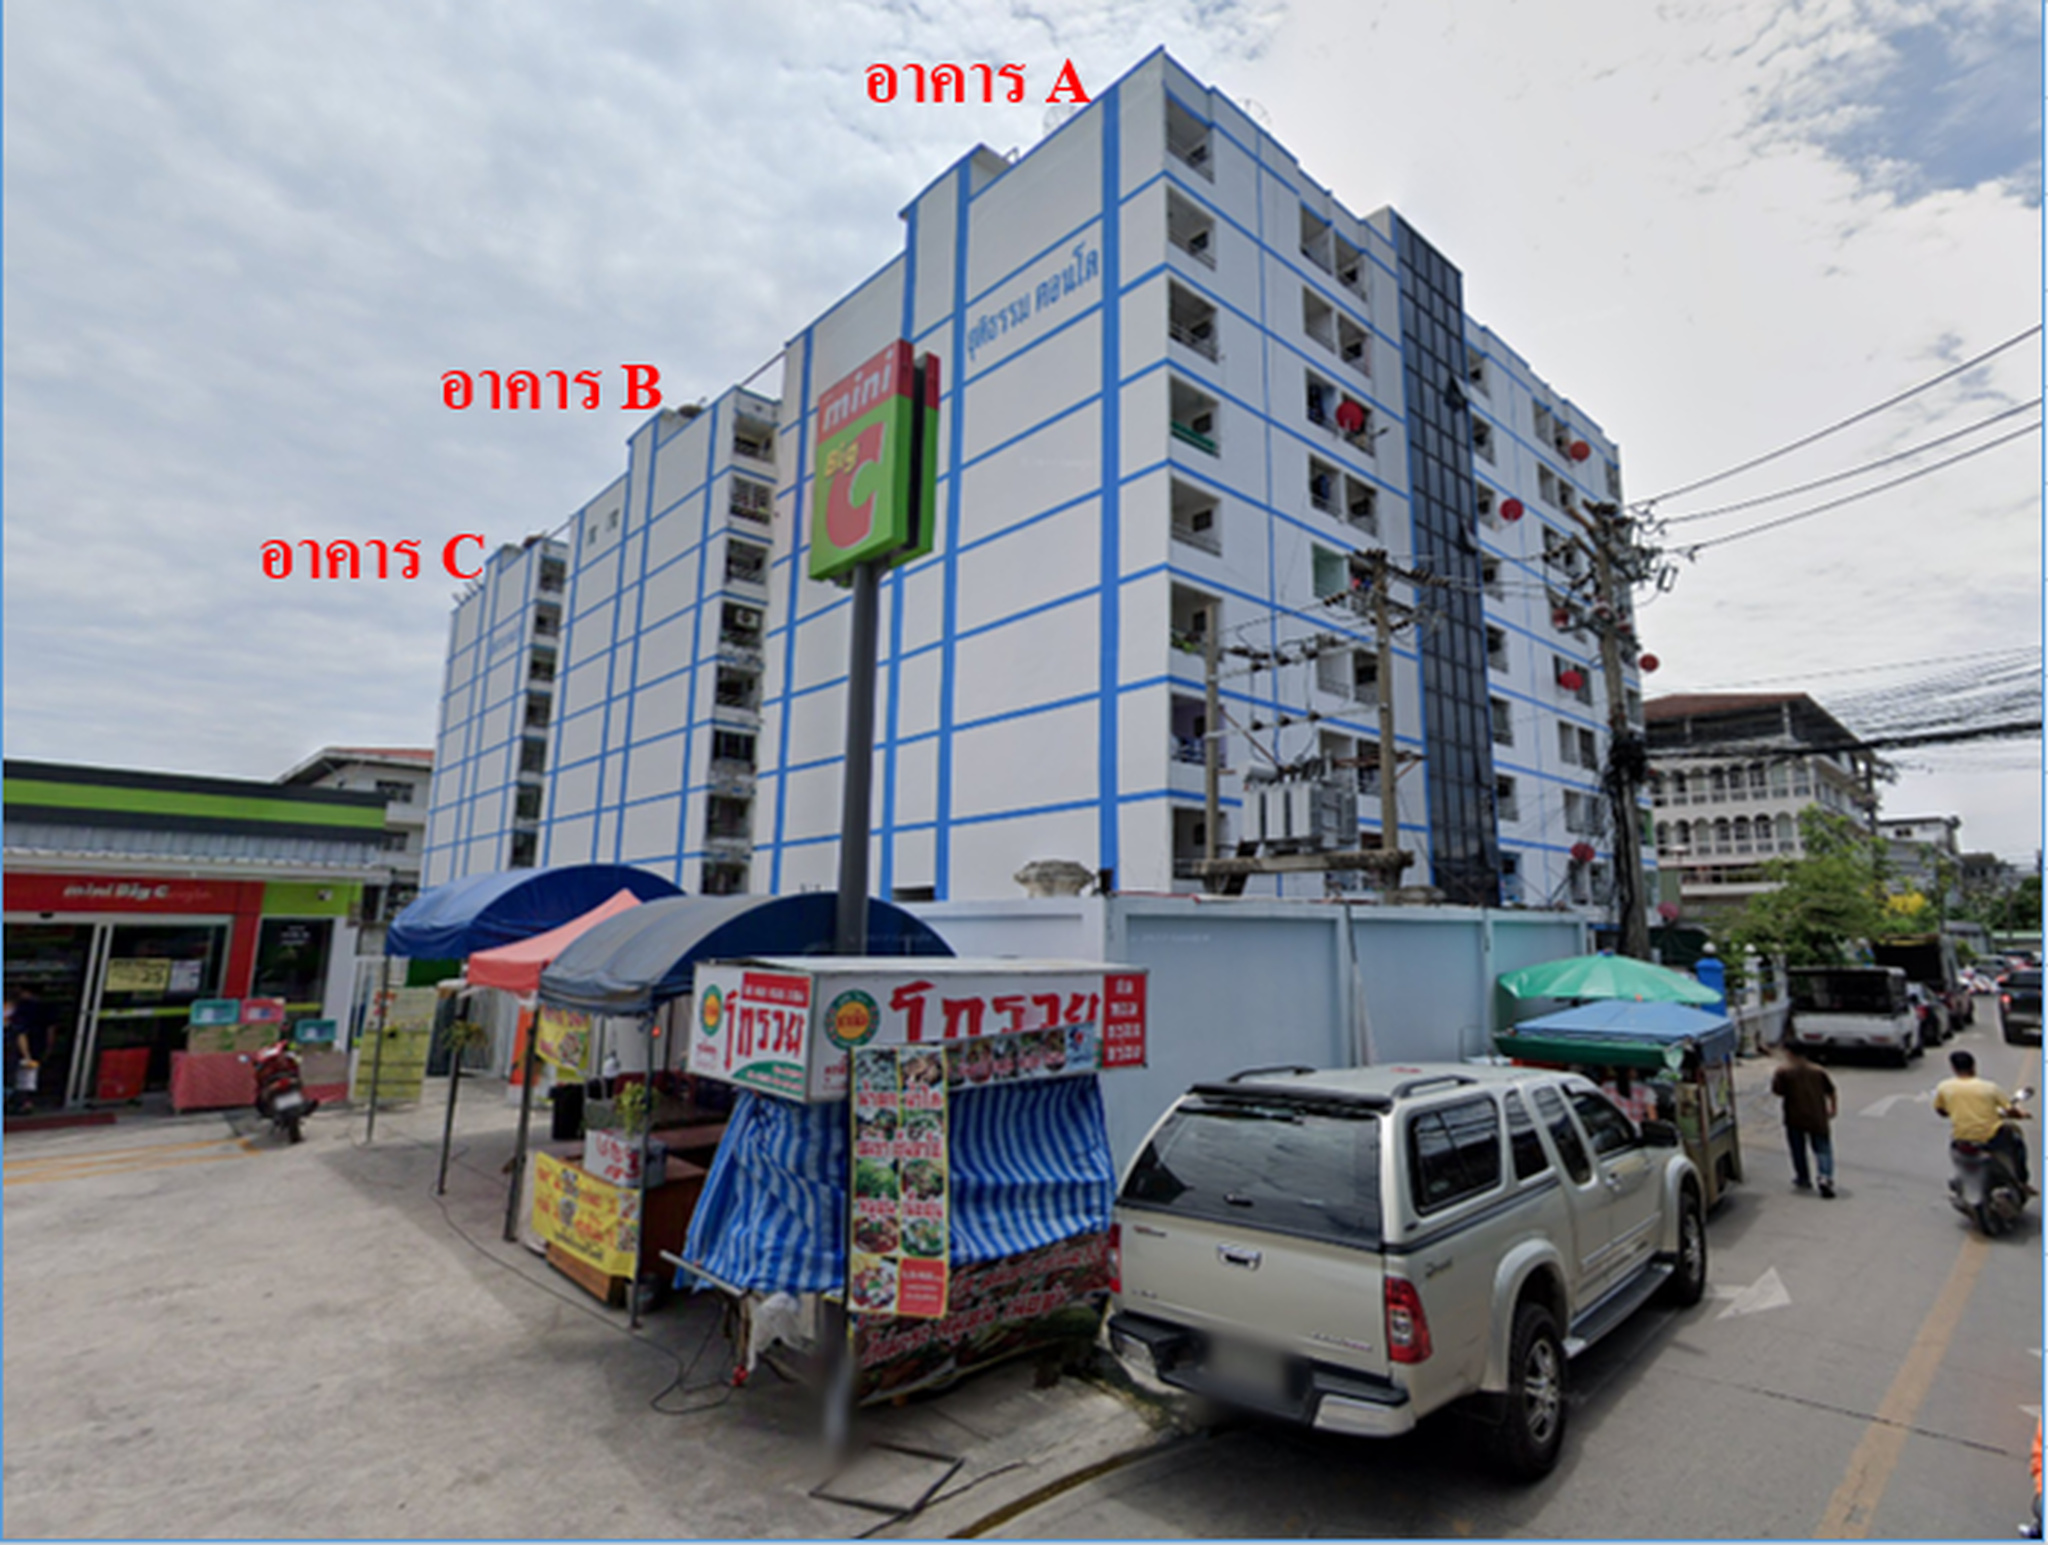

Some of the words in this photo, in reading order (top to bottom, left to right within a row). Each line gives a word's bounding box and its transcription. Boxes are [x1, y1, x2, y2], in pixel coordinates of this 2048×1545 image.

[967, 292, 1031, 362] ยุติธรรม
[1035, 240, 1099, 313] คอนโด
[823, 348, 894, 433] mini
[826, 420, 887, 549] C
[63, 884, 114, 899] mini
[115, 883, 152, 901] Big
[154, 884, 170, 899] C
